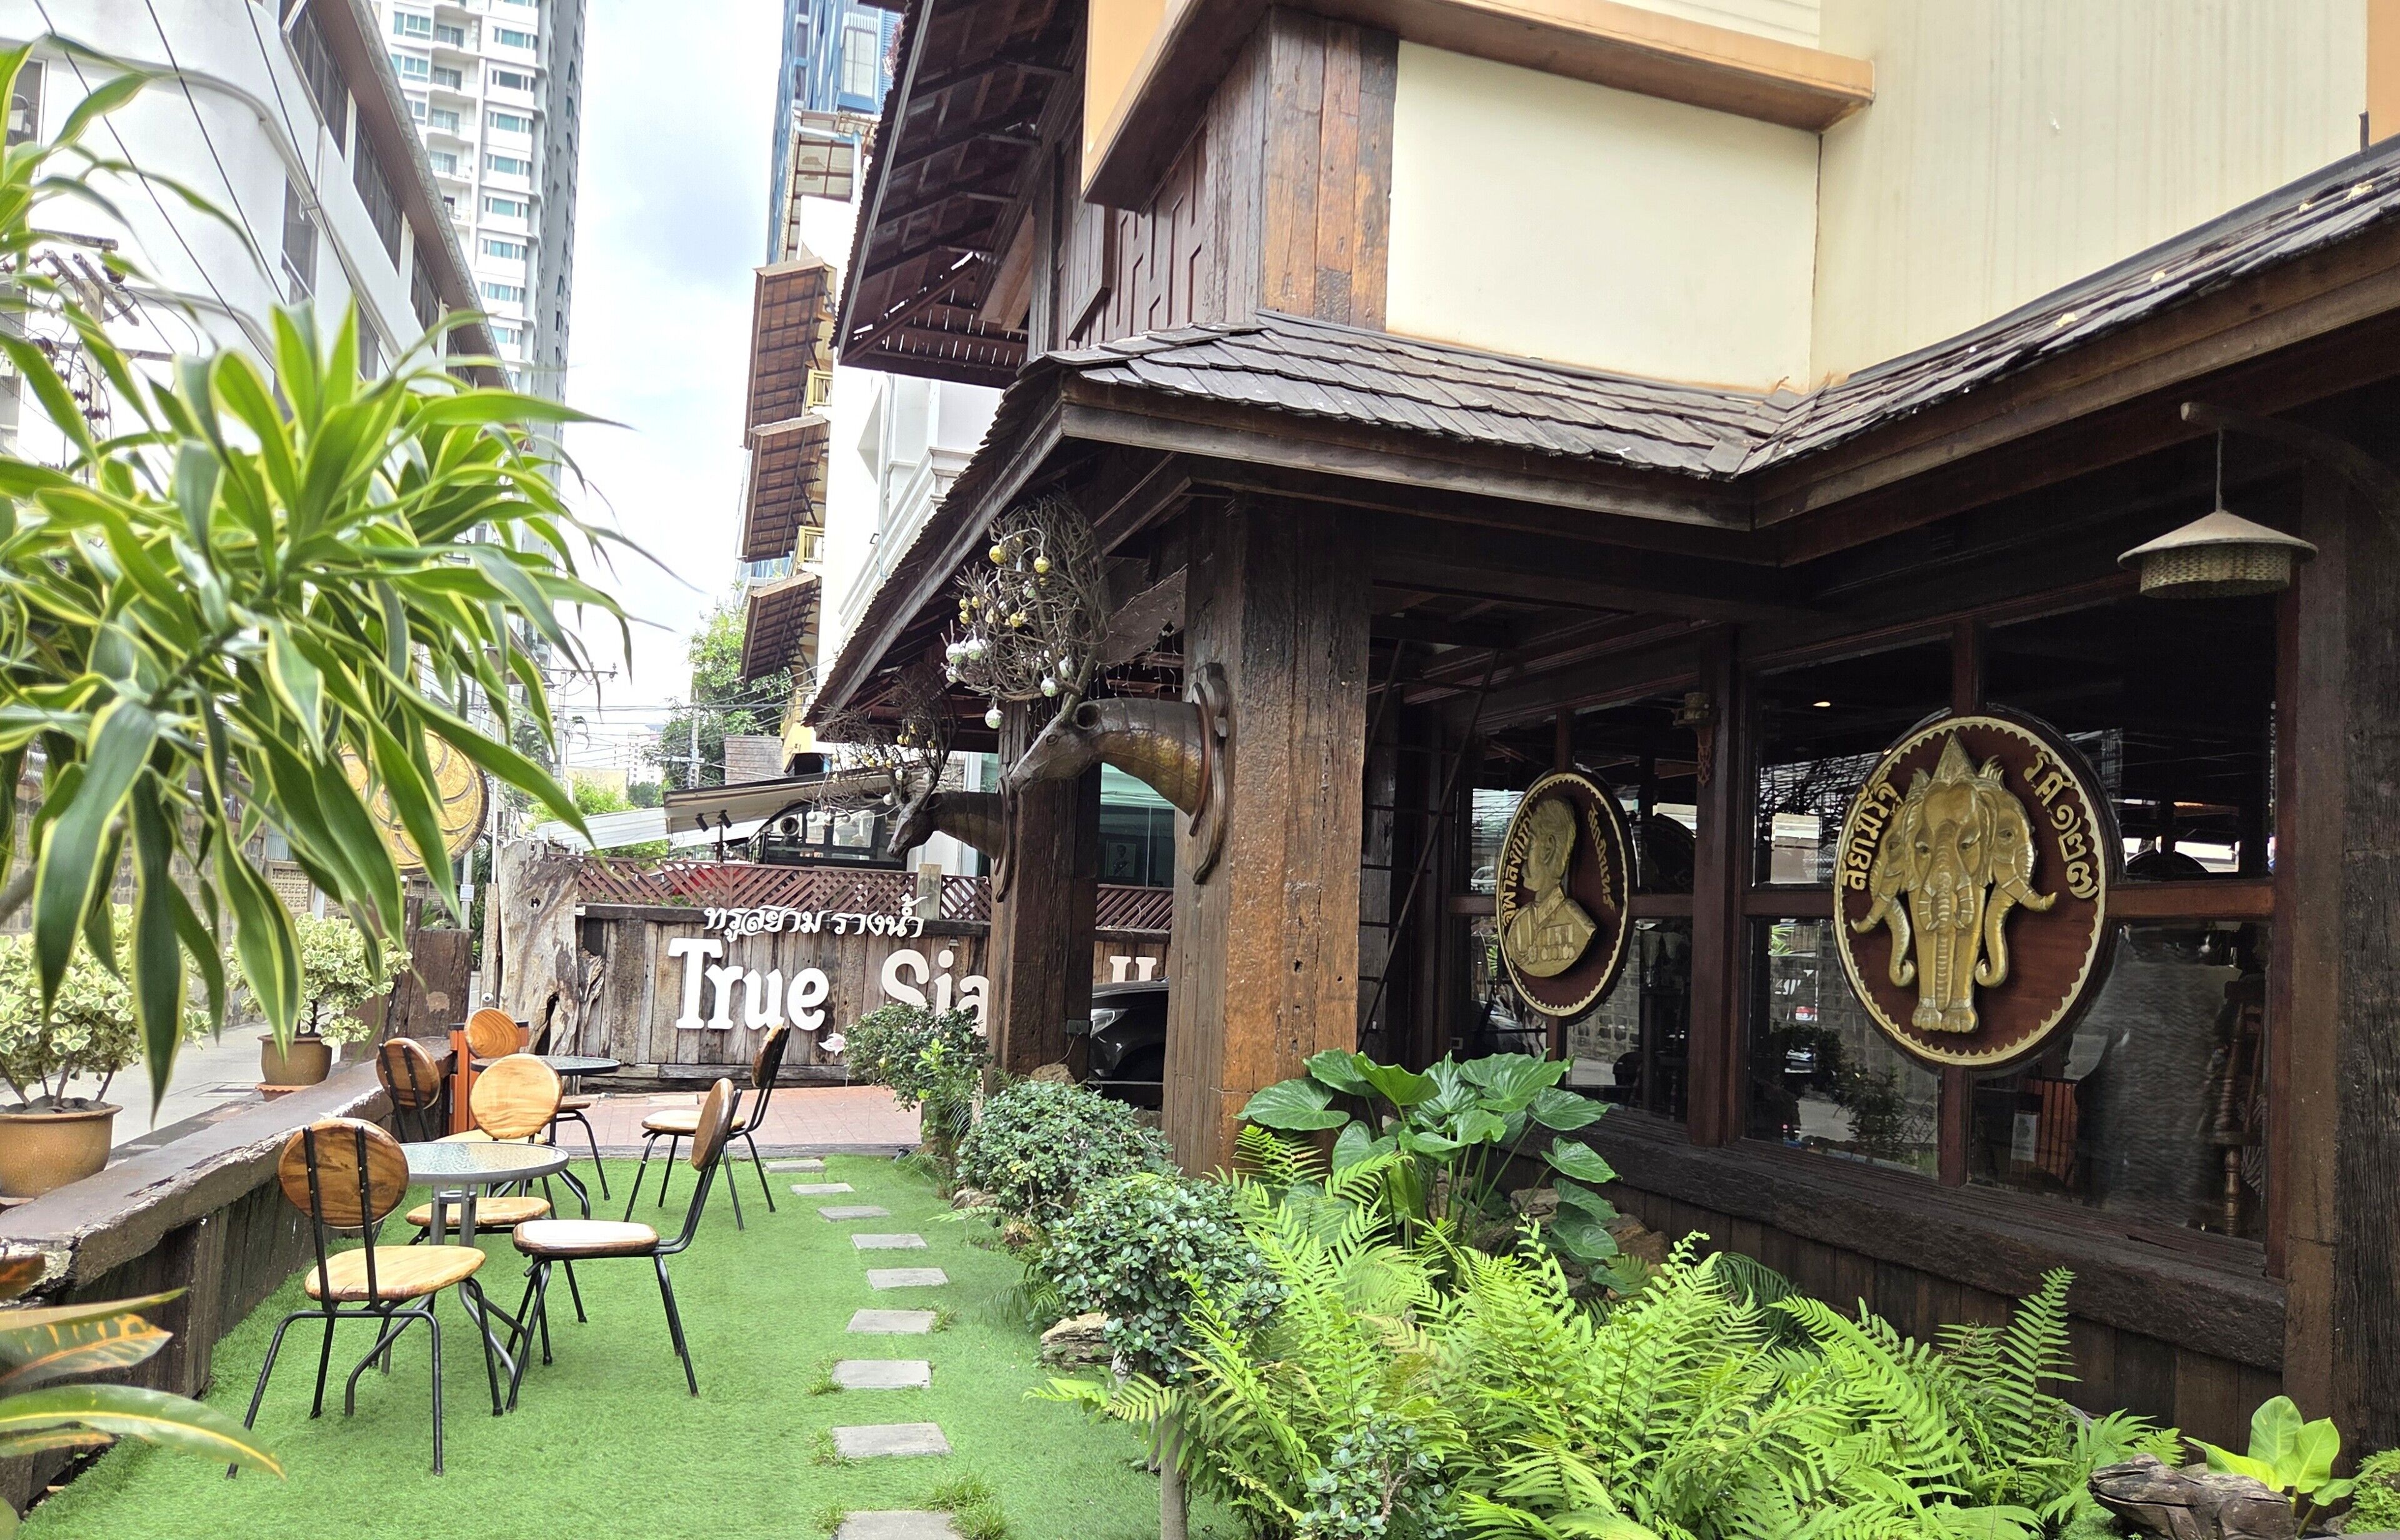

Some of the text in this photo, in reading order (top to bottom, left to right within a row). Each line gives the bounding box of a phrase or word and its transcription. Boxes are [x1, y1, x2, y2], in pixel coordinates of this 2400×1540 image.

[702, 892, 928, 943] ทรูสยาม รางน้ำ
[667, 938, 990, 1036] True Sia
